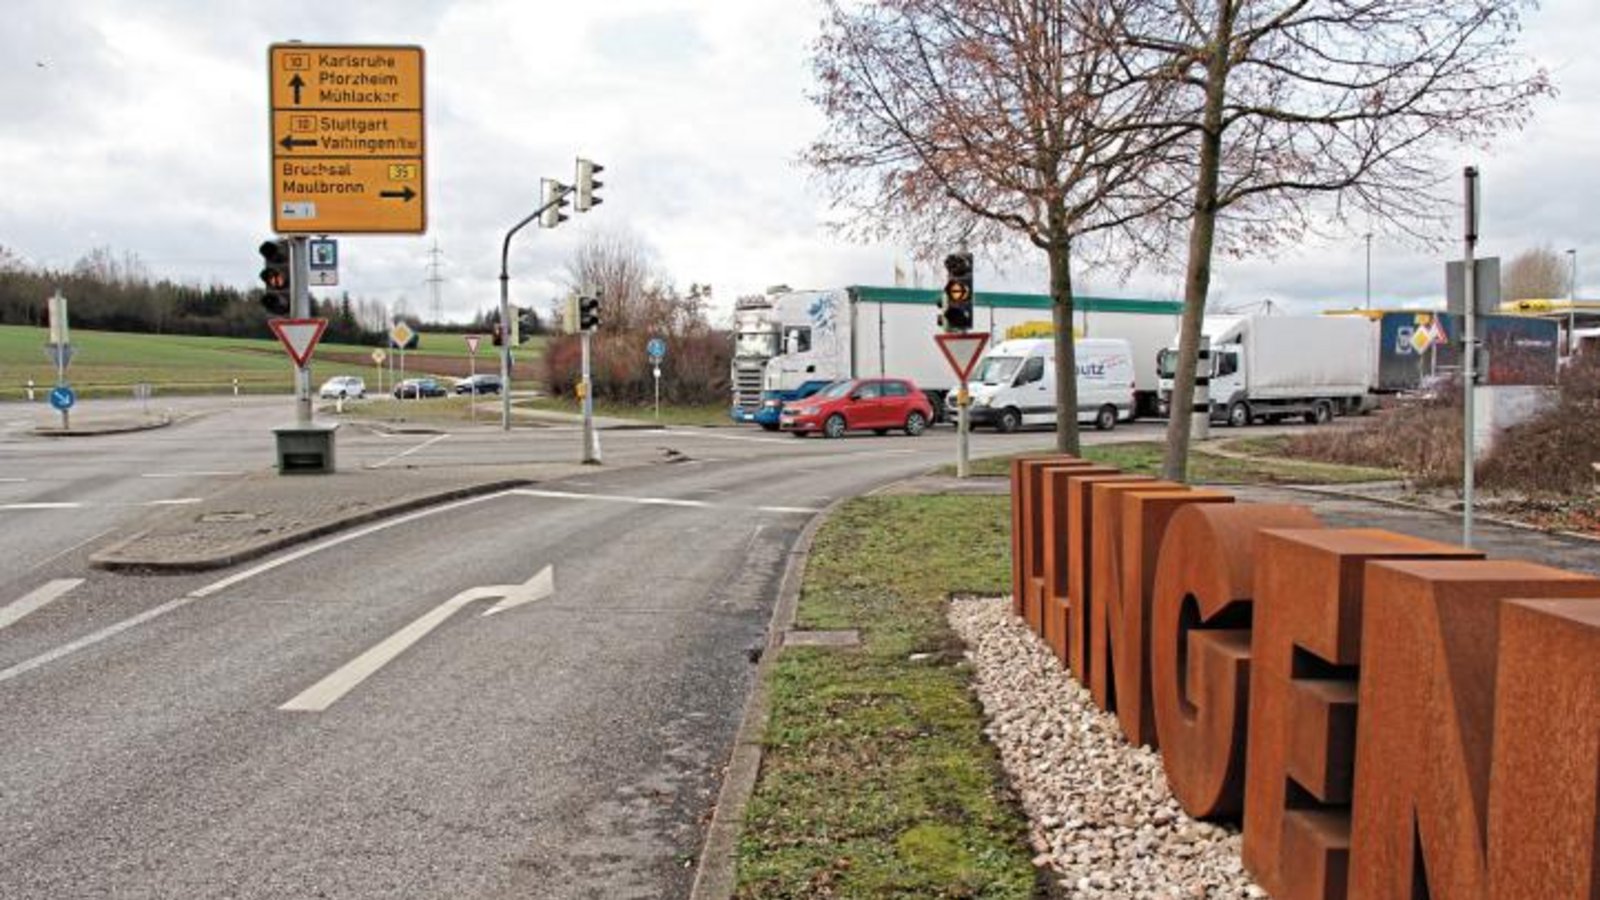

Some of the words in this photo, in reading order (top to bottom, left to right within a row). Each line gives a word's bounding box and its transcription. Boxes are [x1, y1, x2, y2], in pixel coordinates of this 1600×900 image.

[318, 54, 395, 68] Karlsruhe
[318, 71, 397, 86] Pforzheim
[319, 89, 399, 103] Mühlacker
[319, 116, 388, 132] Stuttgart
[282, 162, 351, 176] Bruchsal
[394, 165, 408, 178] 35
[282, 180, 364, 193] Maulbronn
